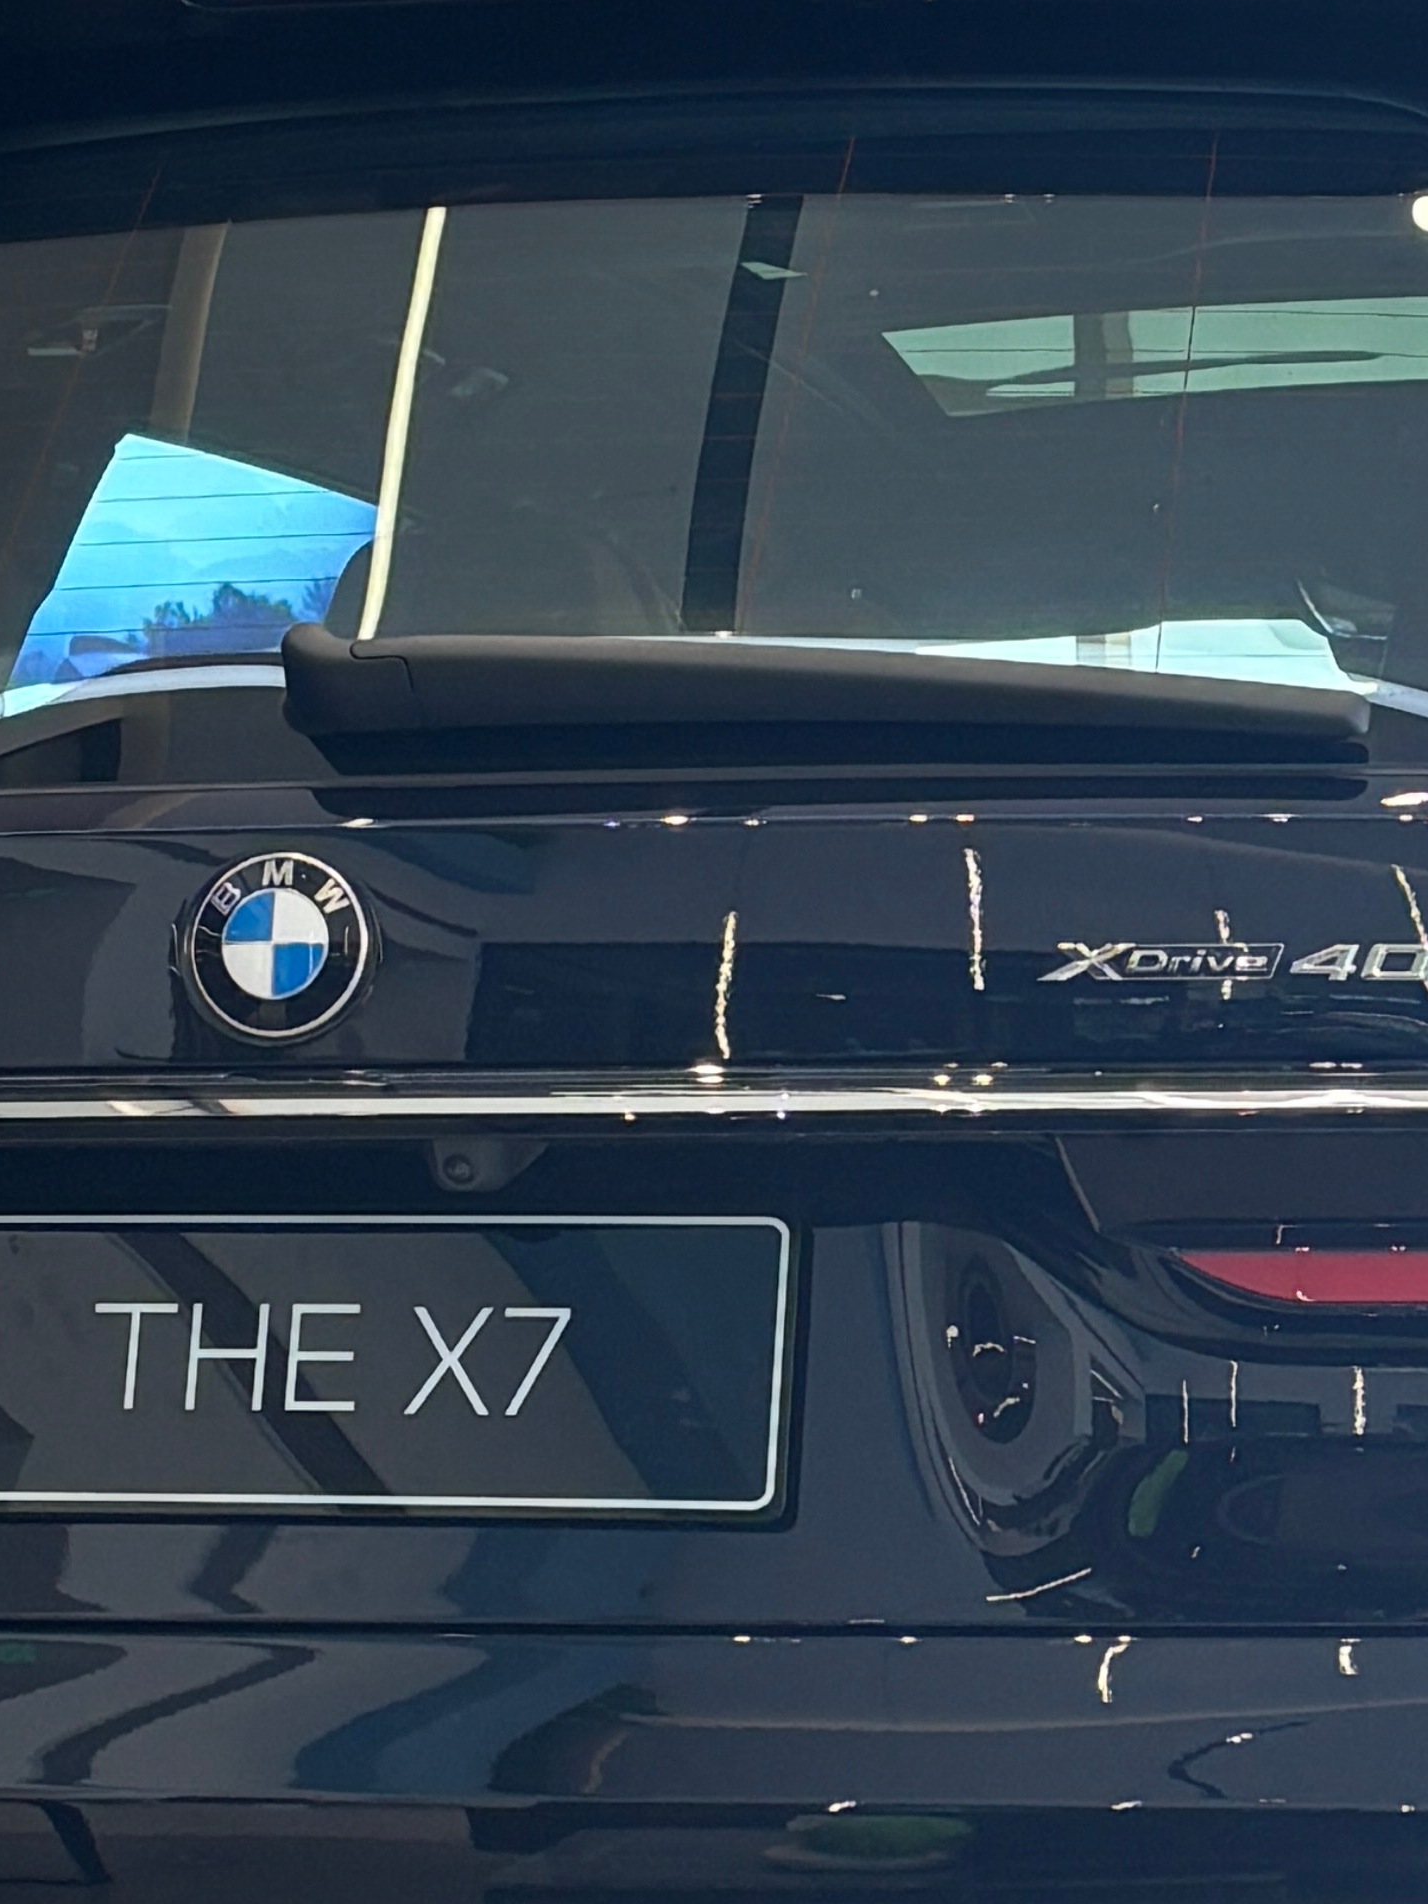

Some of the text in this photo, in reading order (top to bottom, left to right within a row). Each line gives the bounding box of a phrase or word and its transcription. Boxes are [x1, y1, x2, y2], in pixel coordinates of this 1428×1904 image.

[211, 860, 350, 915] BMW
[95, 1303, 571, 1416] THE X7
